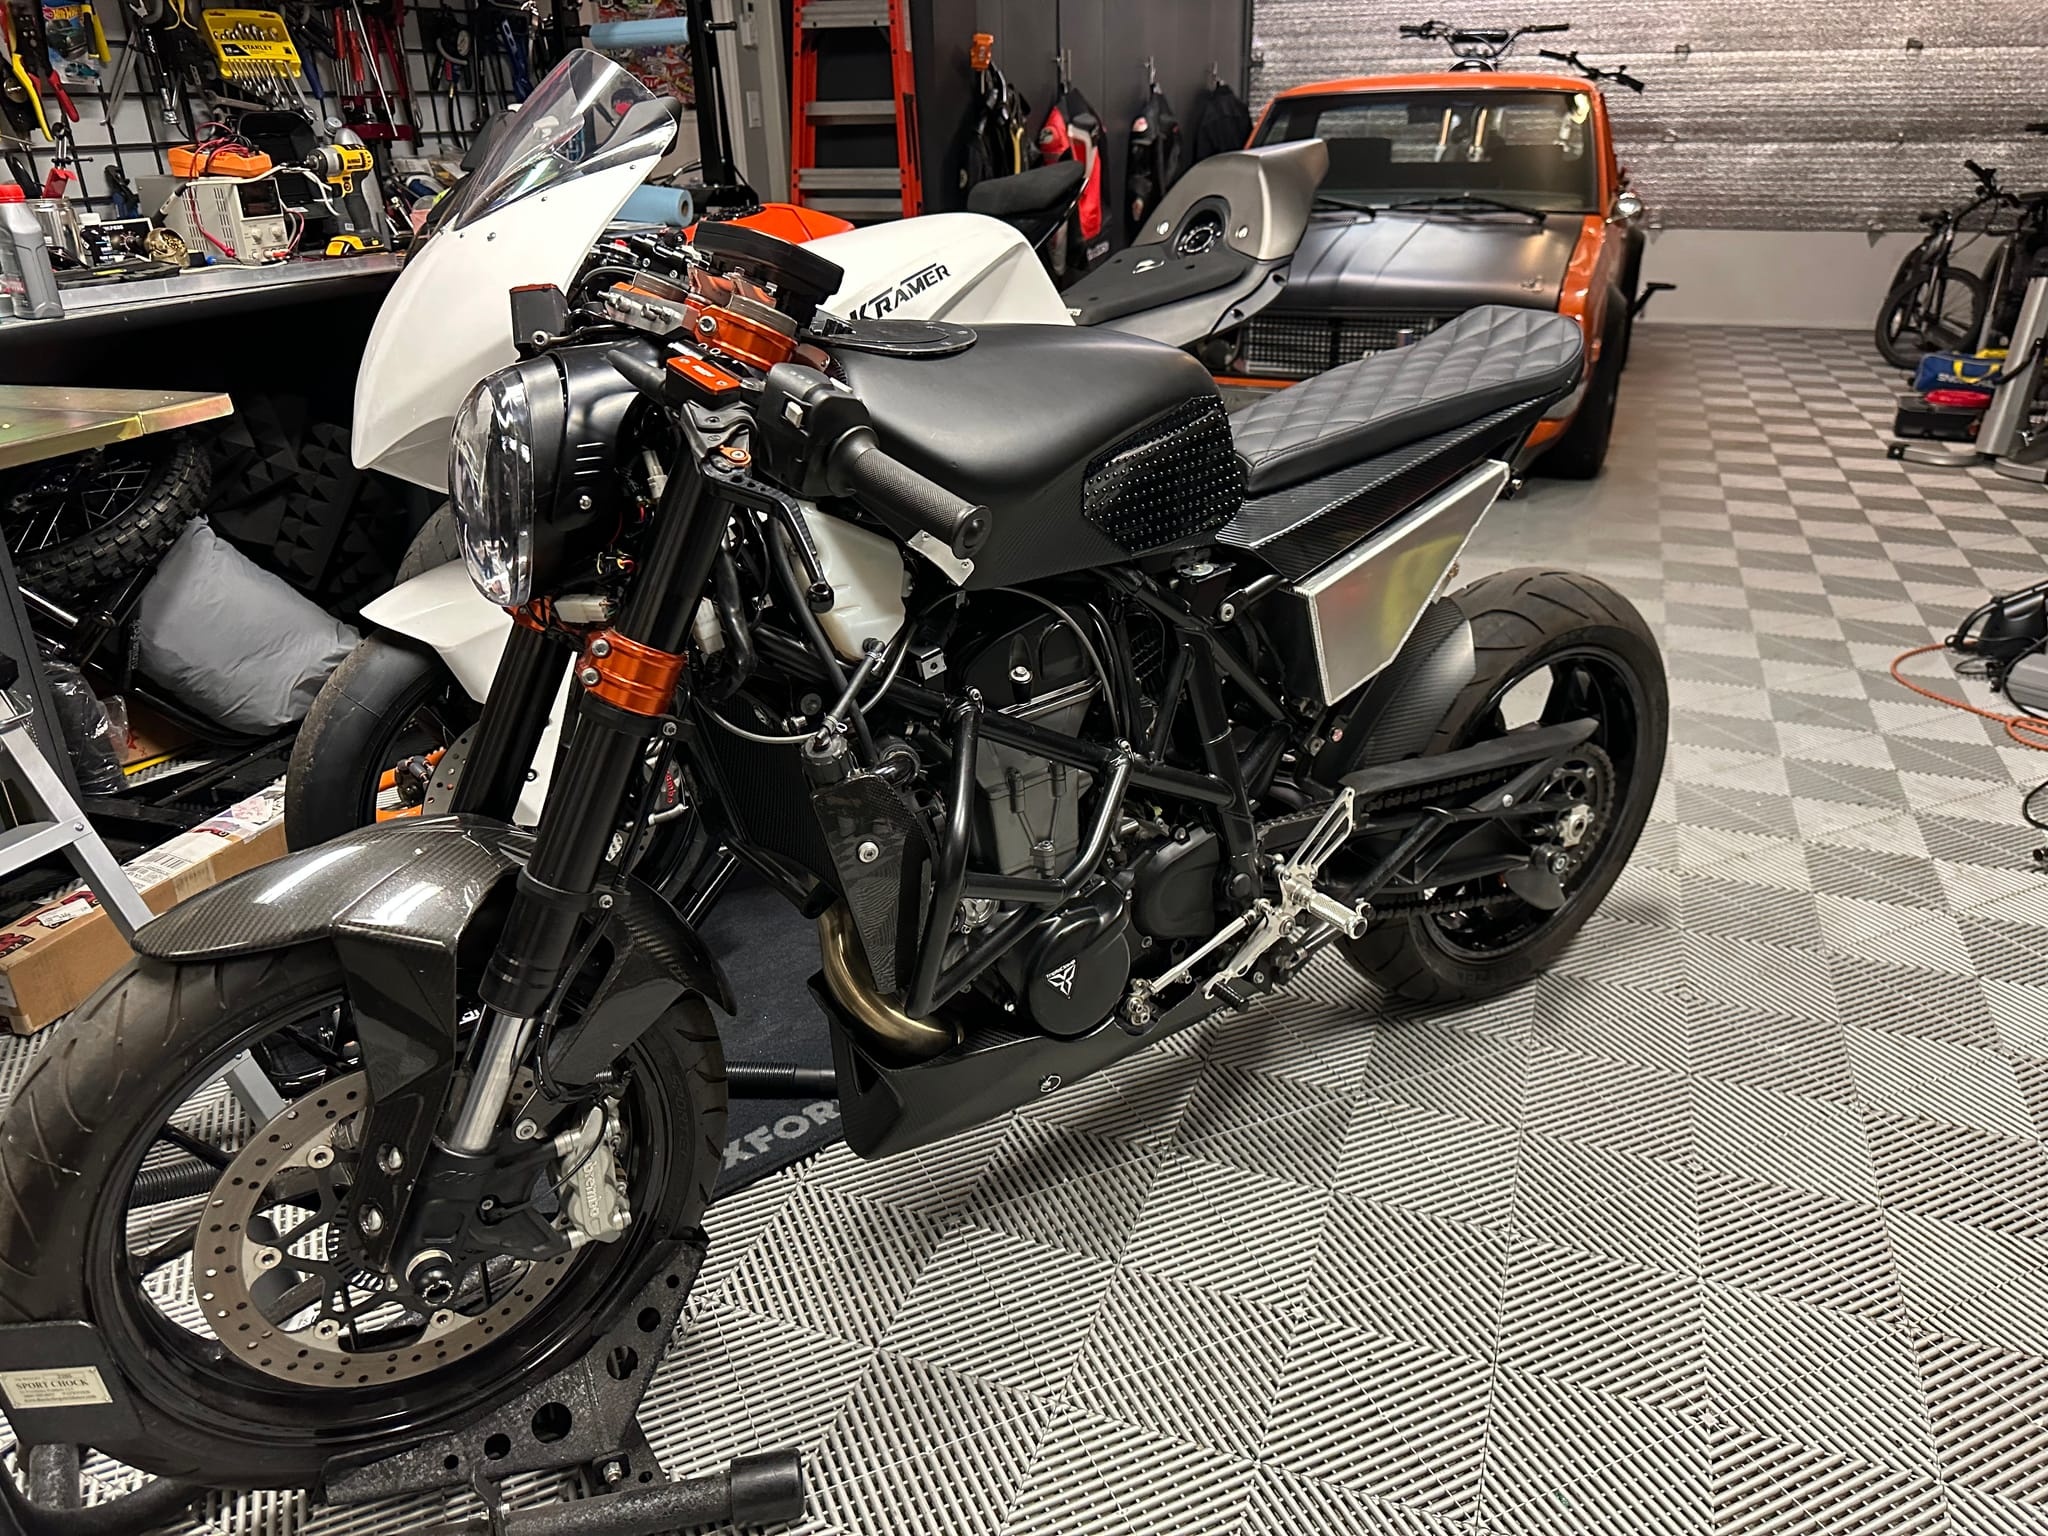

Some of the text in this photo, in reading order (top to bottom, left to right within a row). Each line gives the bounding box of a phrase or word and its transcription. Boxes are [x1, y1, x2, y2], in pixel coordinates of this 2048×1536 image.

[849, 263, 951, 321] KRAMER
[722, 1099, 841, 1170] XFOR
[583, 1160, 600, 1218] brembo
[16, 1379, 89, 1390] SPORT CHOCK
